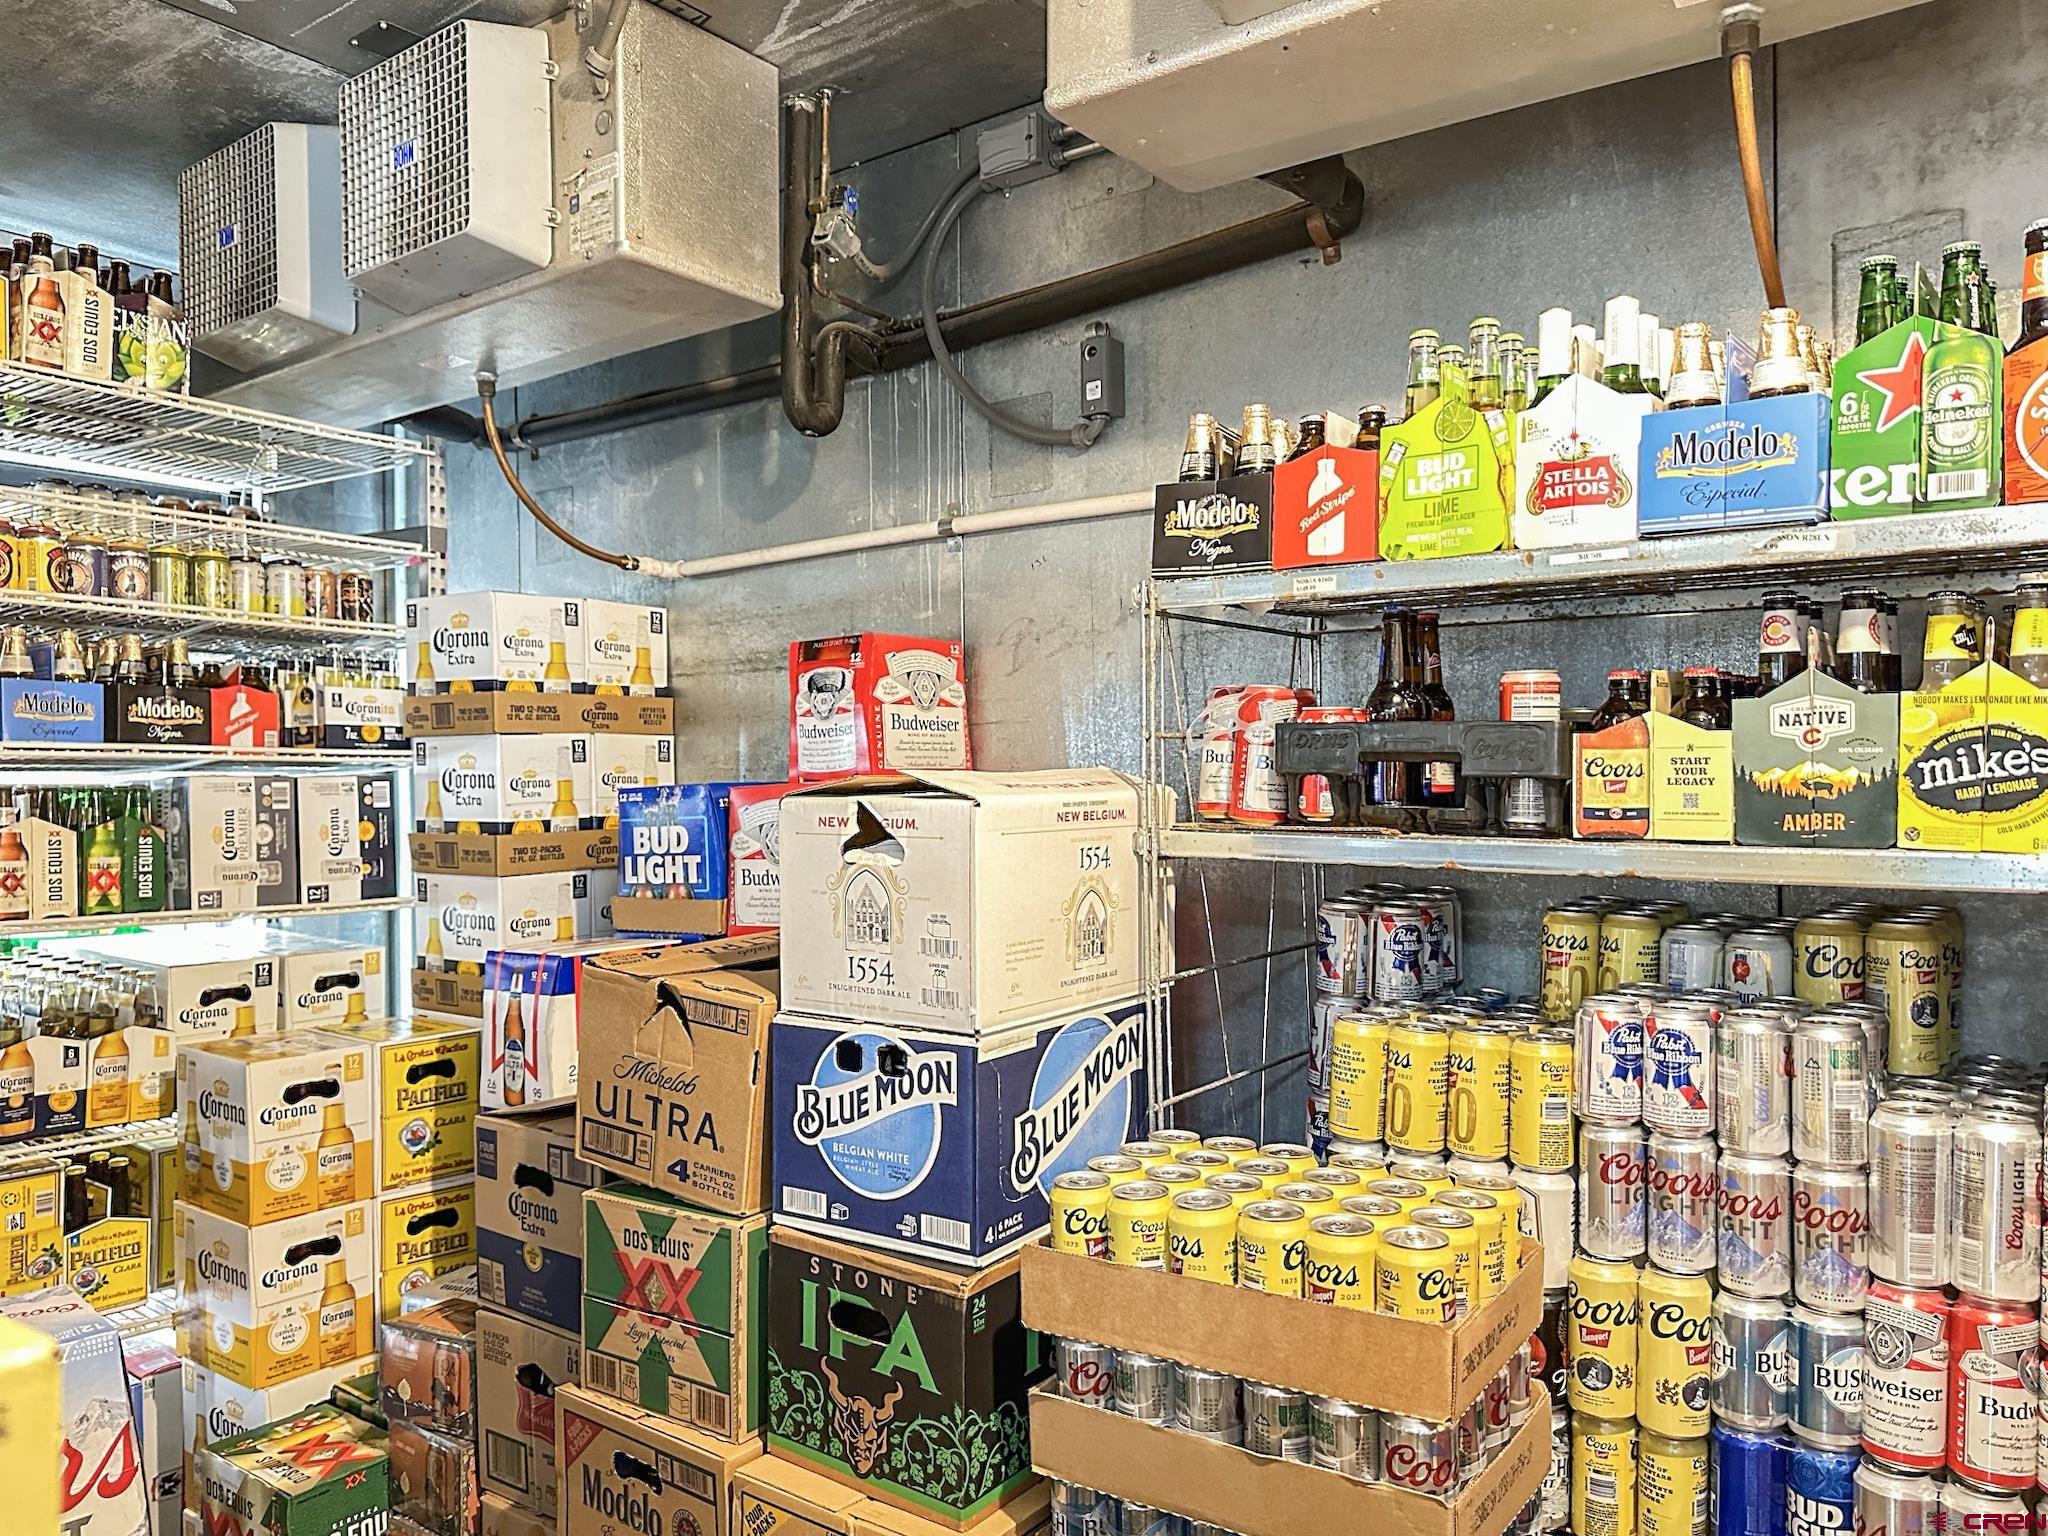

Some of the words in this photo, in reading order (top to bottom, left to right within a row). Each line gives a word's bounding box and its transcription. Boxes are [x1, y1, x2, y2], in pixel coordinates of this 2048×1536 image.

[88, 298, 100, 337] EQUIS
[113, 307, 189, 345] ELYSIAN
[83, 338, 98, 364] DOS
[1840, 392, 1858, 416] 6
[1923, 404, 1991, 425] Heineken
[1837, 416, 1859, 426] PACK
[1837, 423, 1872, 433] IMPORTED
[1672, 424, 1779, 467] Modelo
[1417, 452, 1466, 477] BUD
[1543, 466, 1608, 485] STELLA
[1407, 468, 1475, 496] LIGHT
[1543, 481, 1610, 500] ARTOIS
[1680, 478, 1765, 508] Especial
[1176, 497, 1248, 528] Modelo
[1299, 512, 1322, 534] Red
[1320, 486, 1355, 517] Stripe
[1424, 497, 1459, 518] LIME
[1406, 519, 1435, 529] PREMIUM
[1456, 512, 1476, 522] LAGER
[1189, 538, 1234, 558] Negra
[1420, 543, 1437, 552] LIME
[433, 626, 489, 653] Corona
[504, 633, 544, 649] Corona
[447, 651, 475, 665] Extra
[23, 692, 85, 714] Modelo
[137, 696, 196, 719] Modelo
[510, 705, 526, 714] TWO
[527, 704, 558, 714] 12-PACKS
[1790, 703, 1835, 713] COLORADO
[1913, 695, 1942, 706] NOBODY
[1943, 695, 1969, 705] MAKES
[1970, 695, 2013, 705] LEMONADE
[2015, 695, 2032, 705] LIKE
[799, 722, 853, 739] Budweiser
[891, 712, 959, 732] Budweiser
[1778, 711, 1847, 728] NATIVE
[875, 705, 884, 769] GENUINE
[1585, 757, 1645, 779] Coors
[1670, 757, 1711, 766] START
[1674, 767, 1708, 776] YOUR
[1917, 741, 2048, 791] mike's
[442, 769, 496, 793] Corona
[1238, 744, 1249, 808] GENUINE
[1667, 777, 1716, 786] LEGACY
[1955, 786, 1981, 801] HARD
[1986, 777, 2039, 796] LEMONADE
[818, 816, 849, 829] NEW
[1057, 811, 1081, 823] NEW
[1083, 808, 1127, 821] BELGIUM
[1782, 813, 1846, 832] AMBER
[1997, 824, 2013, 835] COLD
[2014, 819, 2032, 831] HARD
[221, 809, 236, 860] Corona
[328, 808, 341, 856] Corona
[633, 826, 689, 854] BUD
[2033, 838, 2040, 849] 6
[48, 840, 62, 876] EQUIS
[624, 855, 702, 886] LIGHT
[49, 878, 62, 901] DOS
[443, 906, 496, 931] Corona
[1396, 928, 1418, 941] Pabst
[258, 963, 269, 977] 12
[848, 956, 895, 986] 1554
[297, 991, 343, 1010] Corona
[828, 982, 874, 996] ENLIGHTENED
[876, 988, 896, 998] DARK
[898, 990, 911, 999] ALE
[179, 1007, 229, 1024] Corona
[1655, 1033, 1686, 1052] Pabst
[348, 1056, 360, 1068] 12
[1541, 1061, 1570, 1074] Coors
[1667, 1049, 1701, 1065] Ribbon
[613, 1055, 700, 1096] Michelob
[396, 1081, 468, 1110] PACIFICO
[532, 1088, 542, 1099] 95
[797, 1085, 869, 1139] BLUE
[876, 1060, 955, 1113] MOON
[1015, 1098, 1079, 1184] BLUE
[1084, 1022, 1143, 1097] MOON
[200, 1089, 246, 1126] Corona
[260, 1103, 317, 1126] Corona
[595, 1080, 719, 1153] ULTRA
[832, 1142, 874, 1159] BELGIAN
[877, 1150, 910, 1165] WHITE
[833, 1155, 859, 1164] BELGIAN
[860, 1159, 879, 1169] STYLE
[667, 1158, 690, 1183] 4
[693, 1161, 736, 1182] CARRIERS
[844, 1164, 866, 1174] WHEAT
[867, 1167, 879, 1175] ALE
[692, 1180, 735, 1201] BOTTLES
[2013, 1159, 2025, 1204] LIGHT
[508, 1191, 558, 1225] Corona
[518, 1218, 546, 1238] Extra
[985, 1225, 995, 1244] 4
[998, 1220, 1004, 1232] 6
[1004, 1211, 1024, 1230] PACK
[1131, 1220, 1165, 1234] Coors
[2007, 1204, 2024, 1250] Coors
[396, 1232, 469, 1264] PACIFICO
[624, 1228, 648, 1251] DOS
[652, 1238, 694, 1261] EQUIS
[1796, 1229, 1866, 1254] LIGHT
[198, 1249, 247, 1291] Corona
[262, 1262, 318, 1288] Corona
[810, 1255, 918, 1305] STONE
[1280, 1277, 1298, 1286] 1873
[612, 1250, 702, 1337] XX
[972, 1294, 986, 1313] 24
[1340, 1293, 1361, 1301] 2023
[626, 1322, 650, 1344] Lager
[800, 1277, 942, 1396] IPA
[1956, 1380, 1966, 1462] GENUINE
[1585, 1435, 1618, 1452] Coors
[206, 1477, 225, 1503] DOS
[225, 1487, 254, 1520] EQUIS
[582, 1463, 663, 1536] Modelo
[332, 1506, 378, 1529] CERVEZA
[745, 1504, 765, 1525] FOUR
